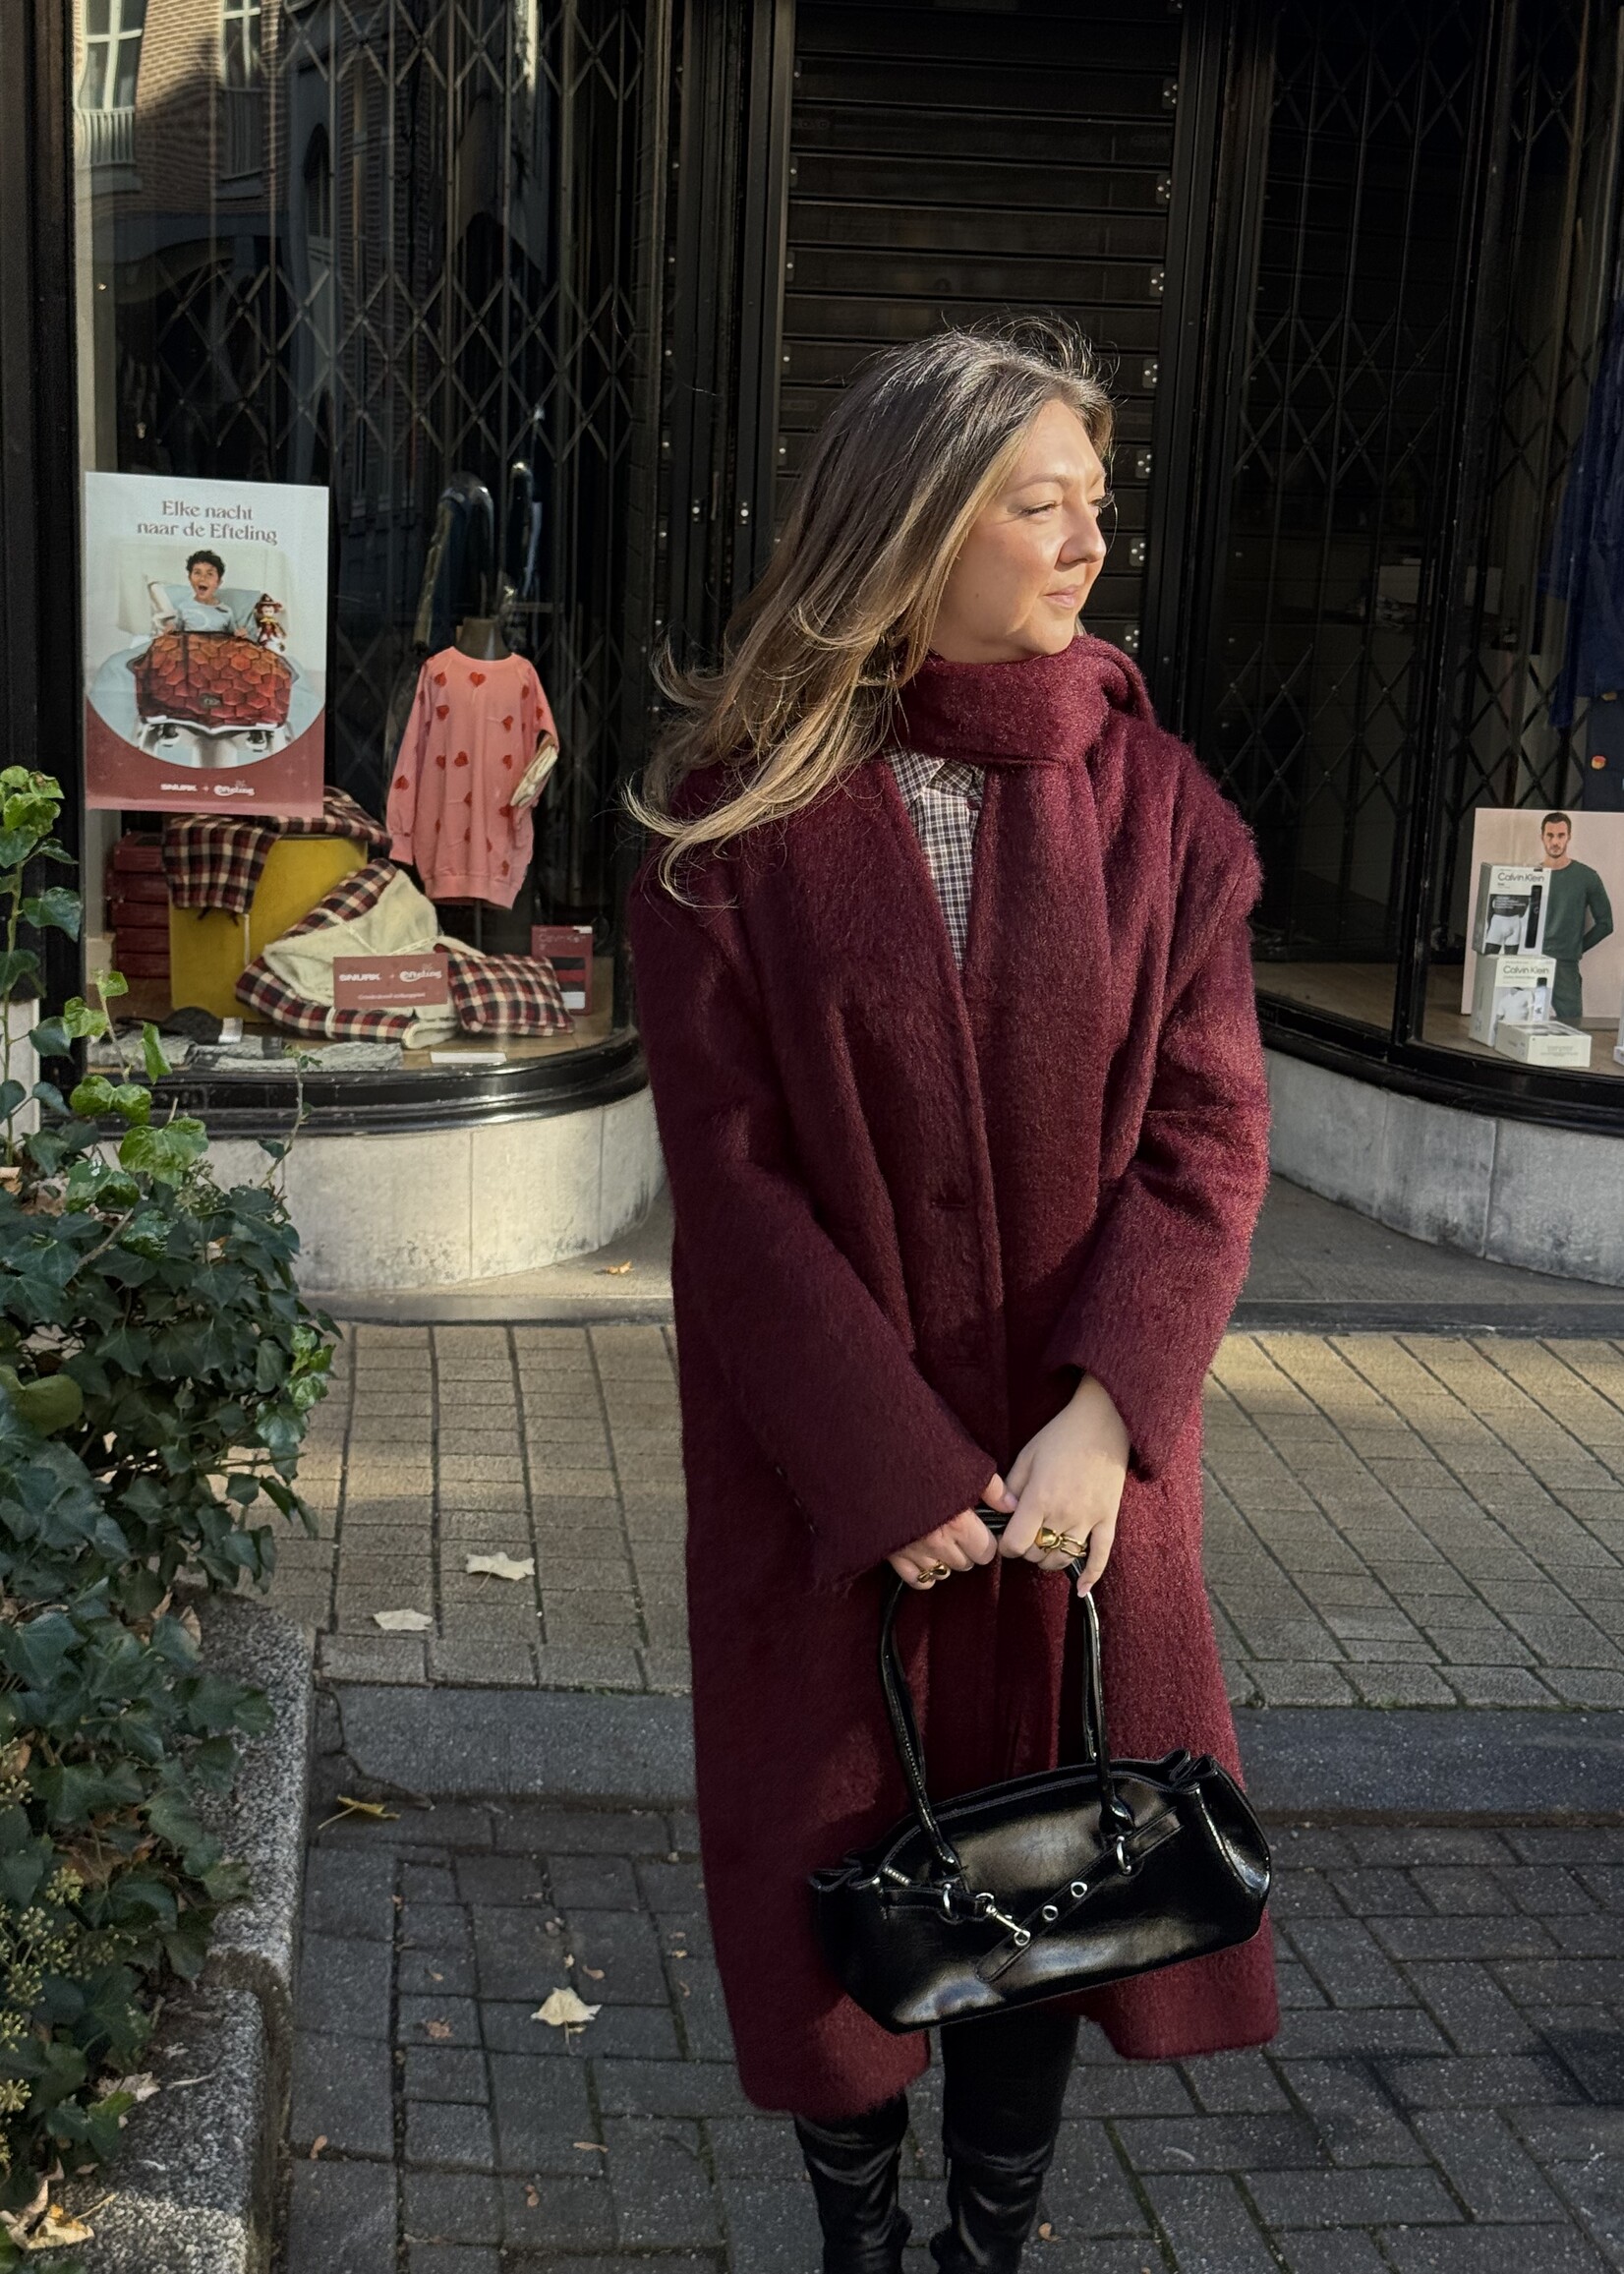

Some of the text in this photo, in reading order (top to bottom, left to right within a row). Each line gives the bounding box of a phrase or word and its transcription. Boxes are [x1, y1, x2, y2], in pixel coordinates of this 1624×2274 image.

[162, 499, 254, 521] Elke nacht
[137, 521, 278, 547] naar de Efteling
[1497, 872, 1544, 883] Calvin Klein
[1503, 965, 1530, 974] Calvin
